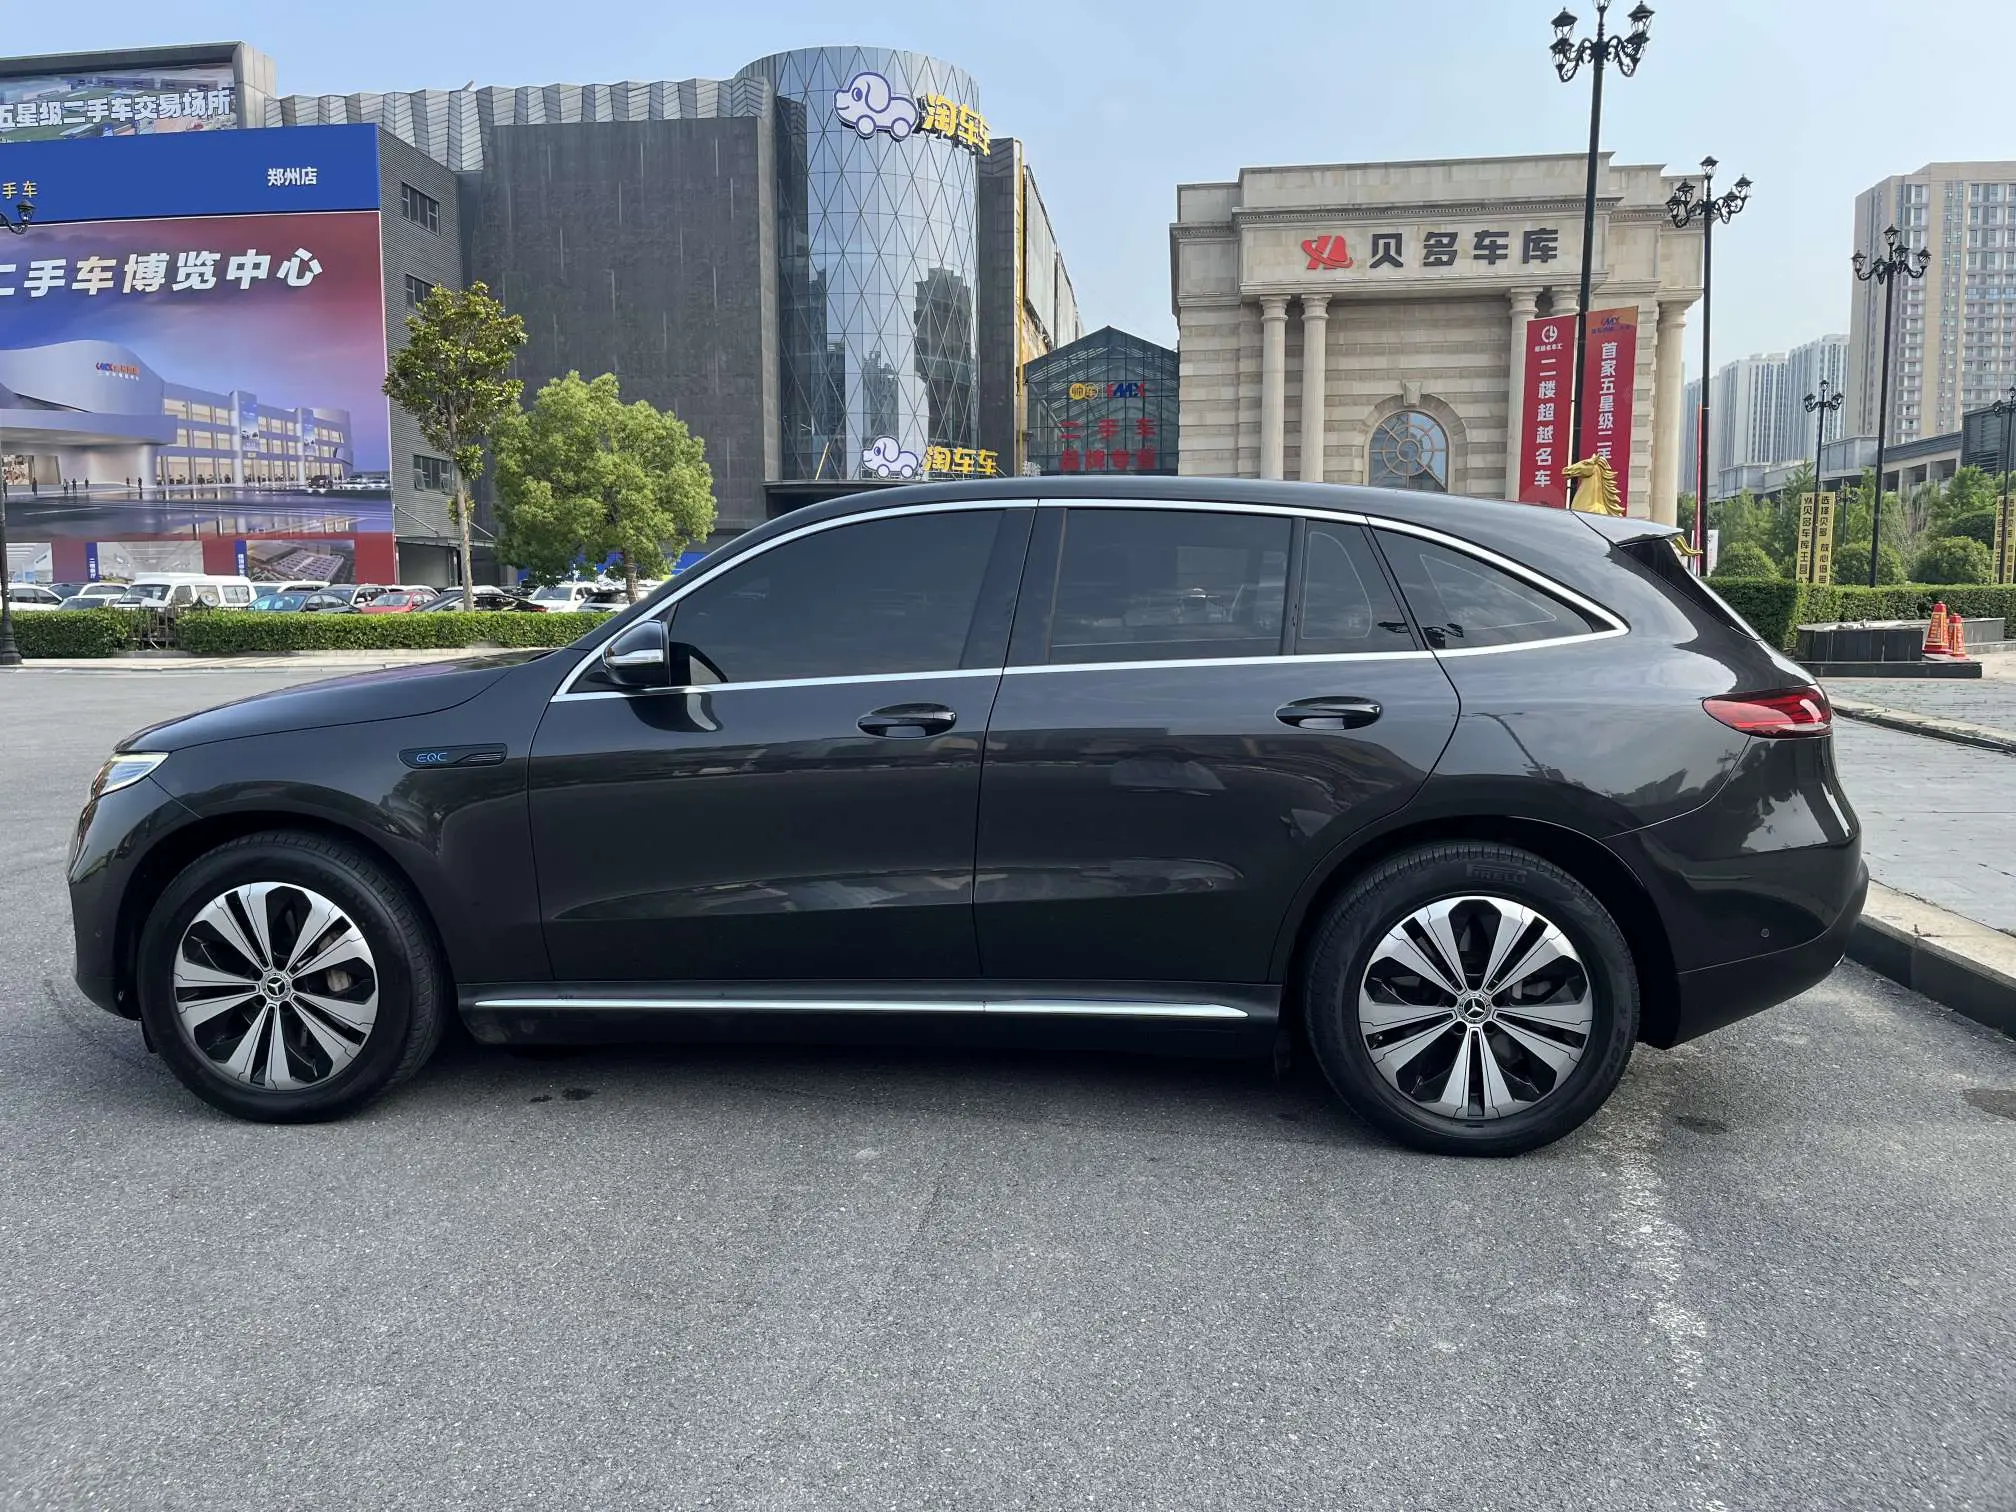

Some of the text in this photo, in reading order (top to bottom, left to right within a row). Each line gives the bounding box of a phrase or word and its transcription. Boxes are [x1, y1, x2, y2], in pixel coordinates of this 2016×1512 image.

[923, 92, 991, 157] 淘车车
[267, 166, 318, 187] 郑州店
[1369, 228, 1559, 269] 贝多车库
[1534, 358, 1557, 488] 二楼超越名车
[923, 445, 999, 475] 淘车车
[416, 752, 448, 763] EQC
